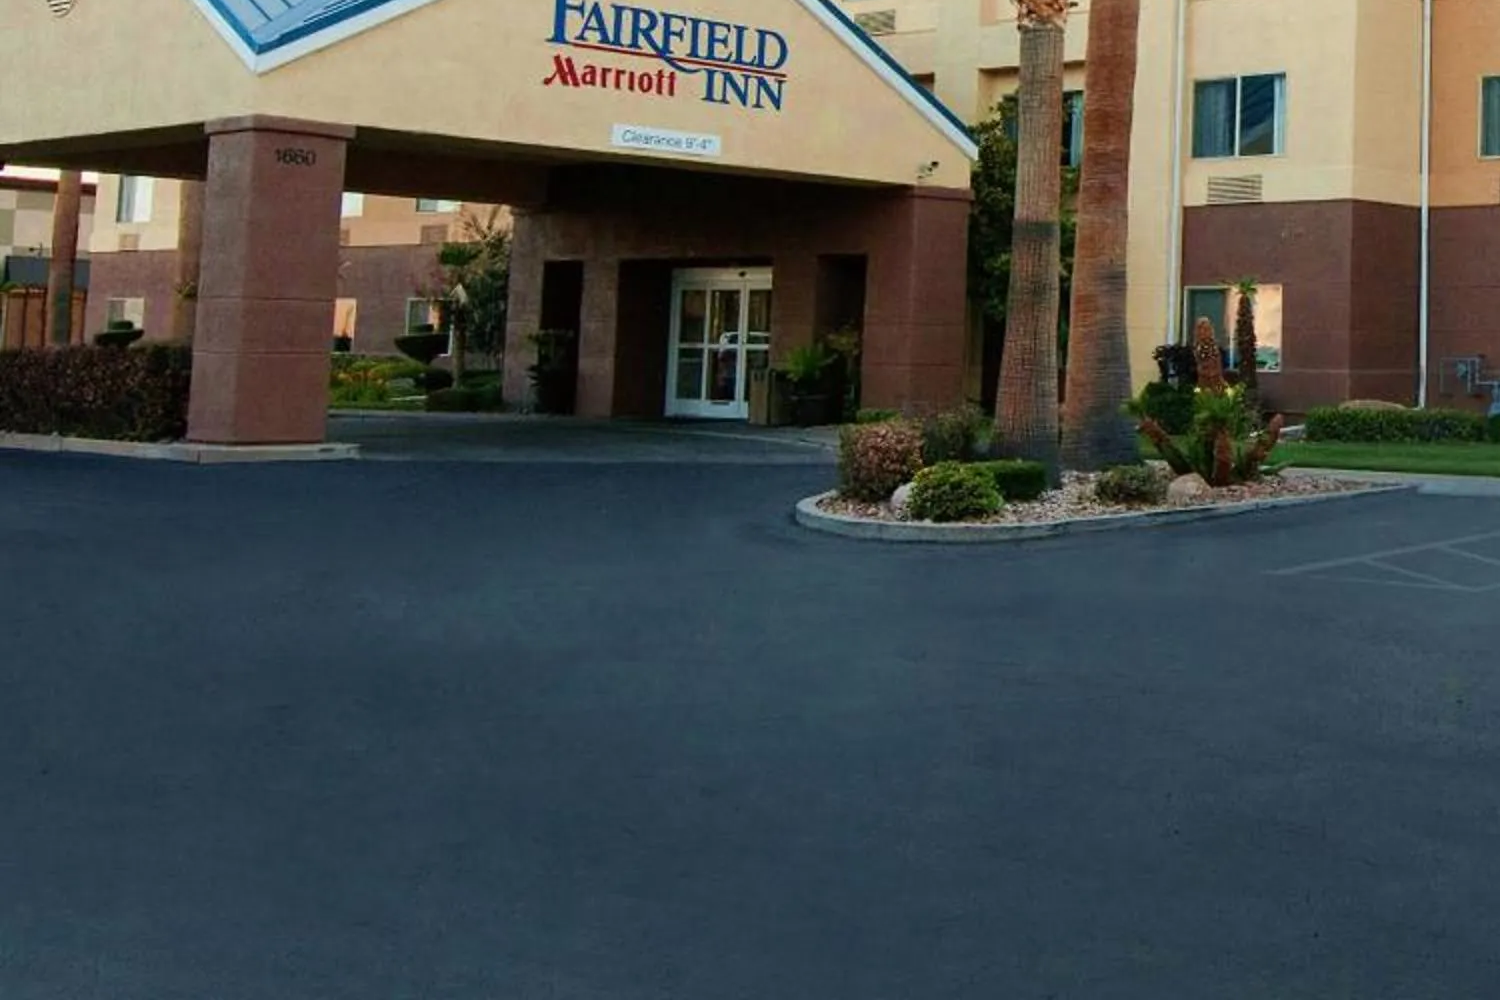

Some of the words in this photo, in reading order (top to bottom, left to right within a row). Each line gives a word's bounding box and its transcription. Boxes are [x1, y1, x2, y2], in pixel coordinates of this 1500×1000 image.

[543, 53, 676, 97] Marriott
[701, 67, 787, 111] INN
[621, 128, 683, 148] Clearance
